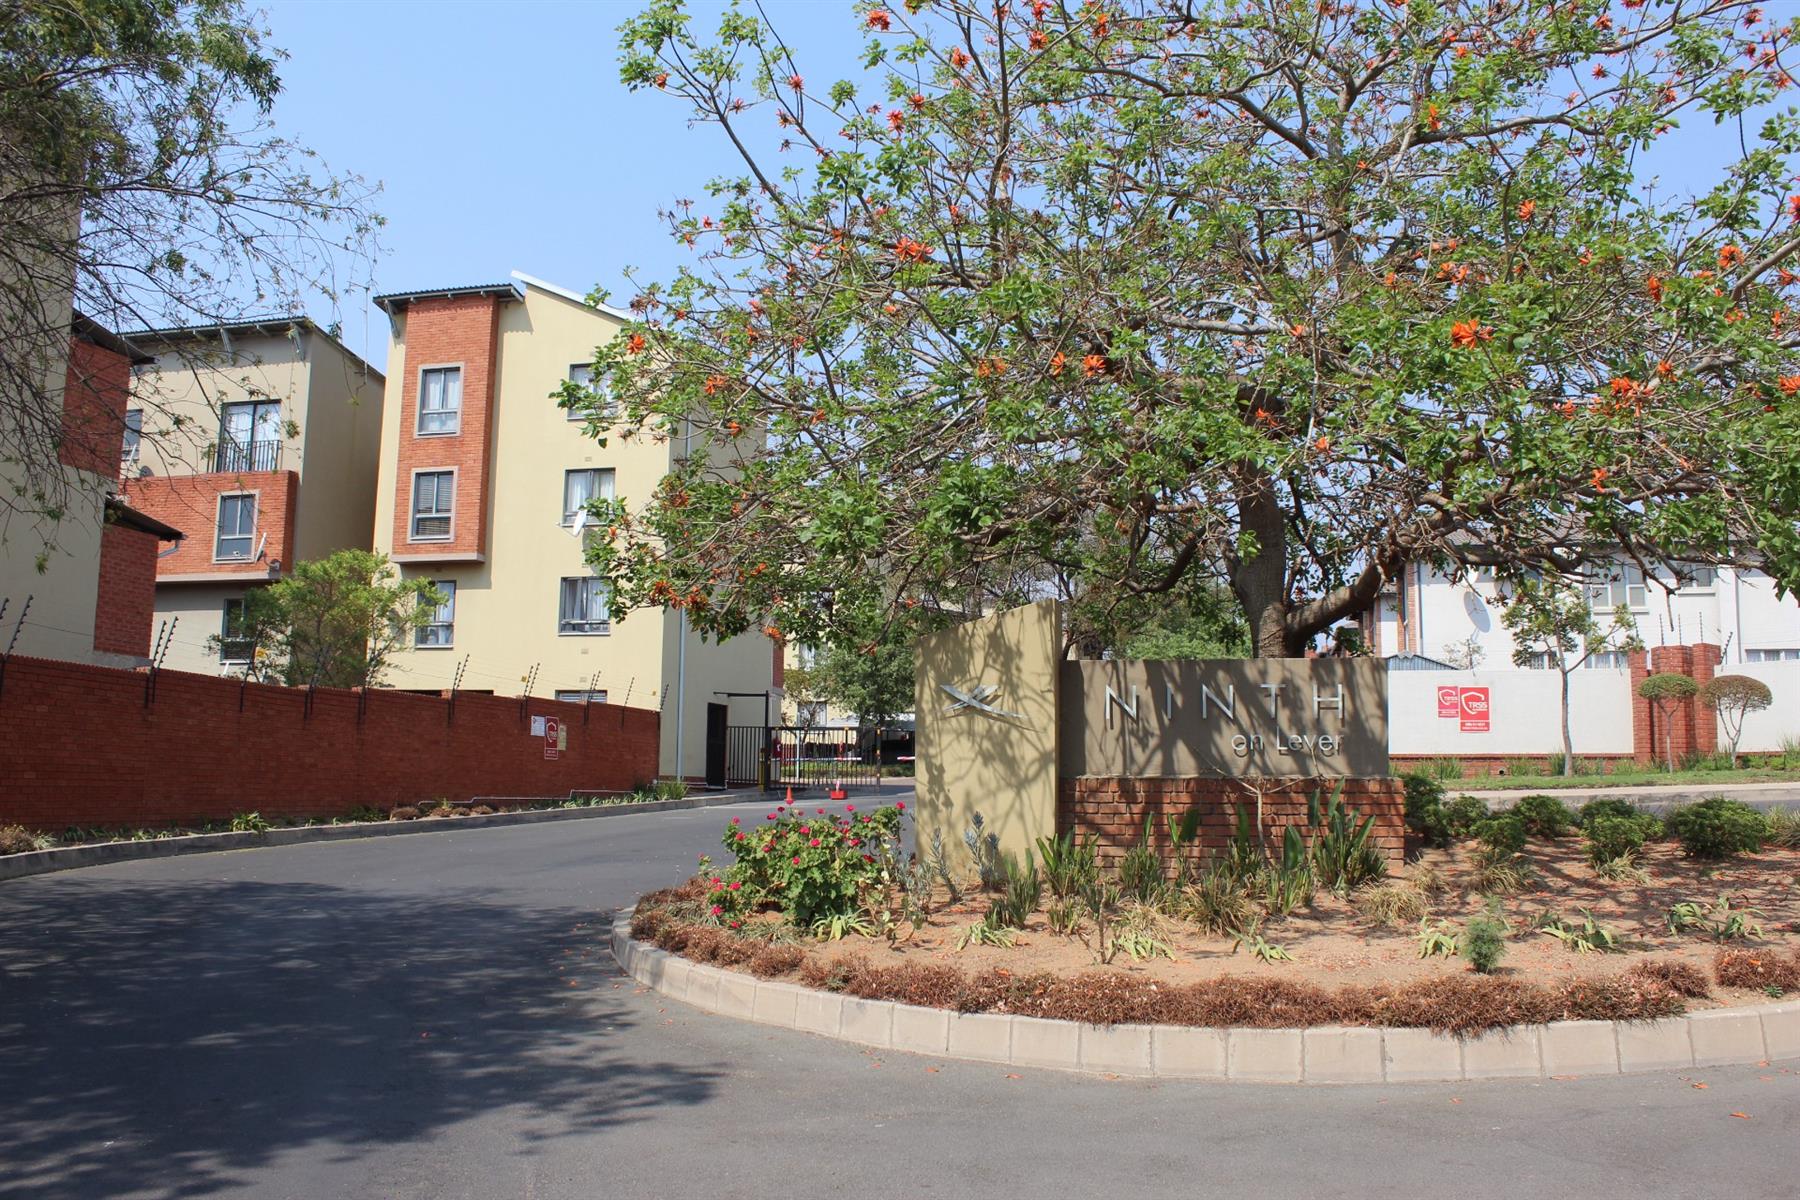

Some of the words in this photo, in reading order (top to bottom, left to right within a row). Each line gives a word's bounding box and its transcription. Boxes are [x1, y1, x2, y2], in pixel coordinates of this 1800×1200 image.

[1105, 684, 1343, 719] NINTH
[1231, 734, 1263, 750] on
[1276, 726, 1343, 750] Lever
